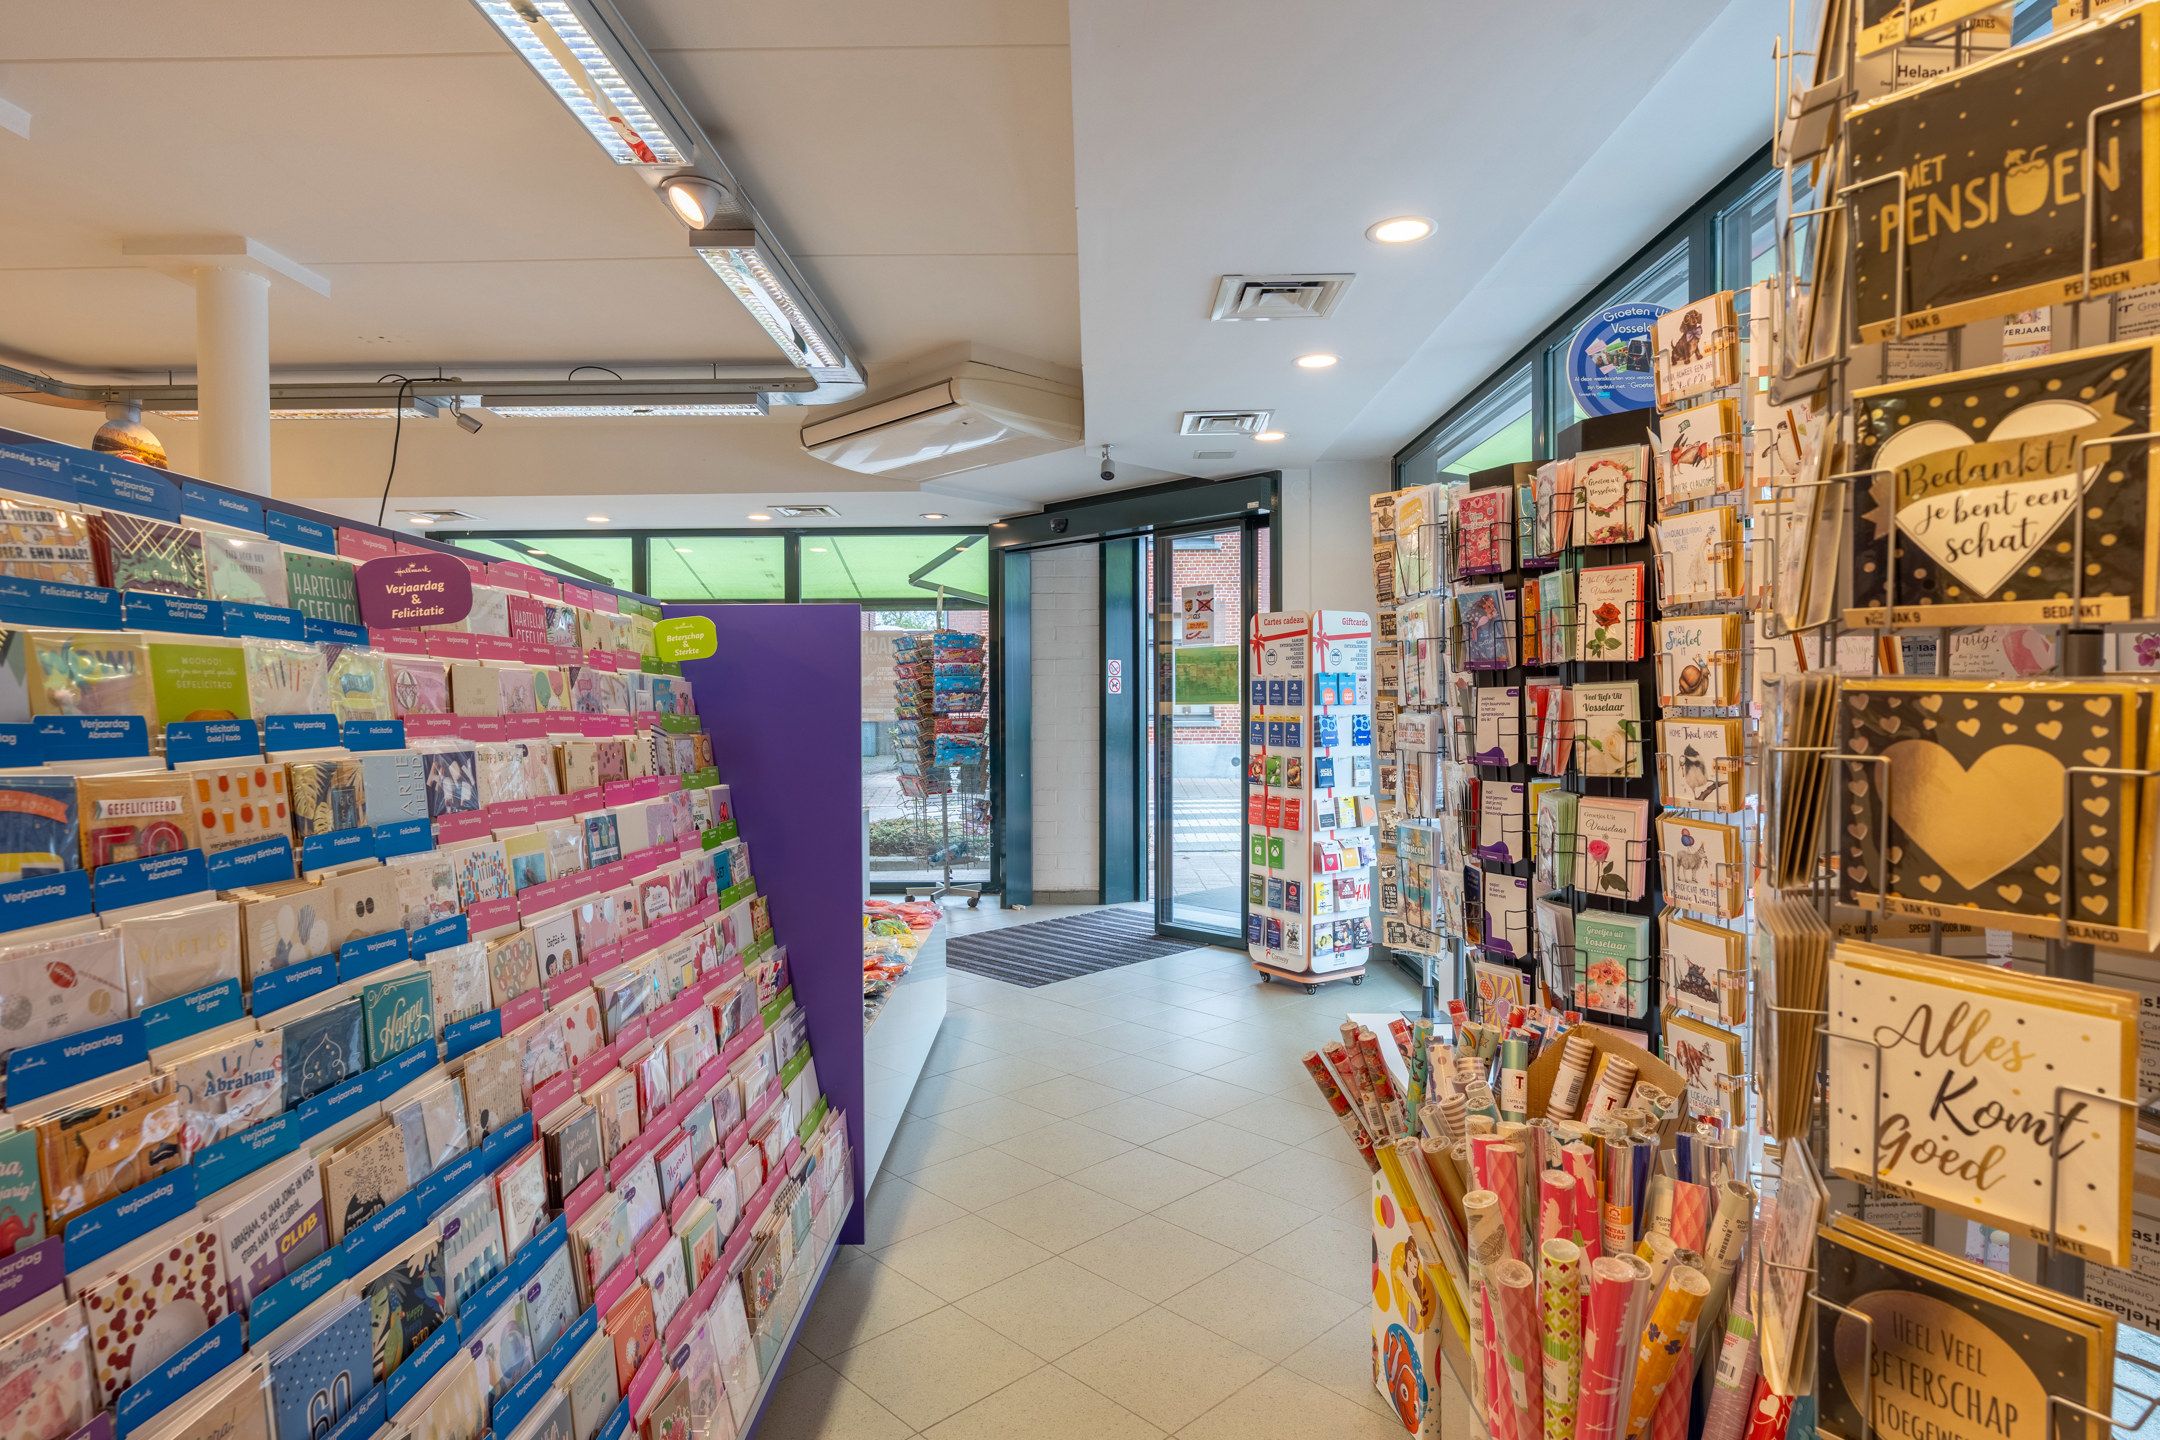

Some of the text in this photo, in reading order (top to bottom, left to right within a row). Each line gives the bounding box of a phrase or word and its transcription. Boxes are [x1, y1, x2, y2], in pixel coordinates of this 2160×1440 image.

[1931, 9, 1937, 21] 7
[1903, 154, 1947, 191] MET
[2064, 271, 2130, 296] PESIOEN
[1603, 307, 1650, 322] Groeten
[1611, 323, 1651, 334] Vossela
[1906, 317, 1930, 330] VAK
[0, 448, 61, 472] jaardag Schijf
[1904, 436, 2078, 497] Bedankt!
[110, 477, 155, 496] Verjaardag
[219, 498, 249, 513] Felicitatie
[1954, 490, 2017, 525] bent
[2025, 487, 2076, 508] een
[297, 525, 323, 538] Felicitatie
[1945, 517, 2042, 564] schat
[292, 573, 354, 600] HARTELIJK
[385, 581, 445, 596] Verjaardag
[40, 586, 109, 604] Felicitatie Schijf
[411, 594, 422, 605] &
[165, 600, 208, 613] Verjaardag
[391, 605, 445, 619] Felicitatie
[254, 611, 290, 624] Verjaardag
[1264, 616, 1304, 626] Cartes cadeau
[1342, 617, 1368, 627] Giftcards
[333, 628, 358, 638] Felicitatie
[392, 635, 418, 645] Verjaardag
[446, 635, 469, 645] Verjaardag
[667, 632, 705, 643] Beterschap
[1665, 627, 1702, 650] Snailed
[675, 648, 700, 657] Sterkte
[1597, 692, 1610, 702] Liefs
[1582, 702, 1625, 712] Vosselaar
[80, 720, 130, 731] Verjaardag
[205, 724, 240, 734] Felicitatie
[293, 721, 327, 731] Verjaardag
[369, 727, 393, 735] Felicitatie
[88, 731, 124, 739] Abraham
[1703, 729, 1719, 739] HOME
[107, 800, 177, 815] GEFELICITEERD
[400, 825, 421, 835] Felicitatie
[1585, 819, 1627, 834] Vosselaar
[334, 836, 361, 847] Felicitatie
[234, 846, 285, 864] Happy Birthday
[139, 856, 188, 872] Verjaardag
[148, 867, 183, 881] Abraham
[3, 885, 66, 903] Verjaardag
[480, 886, 495, 898] YAY!
[1902, 903, 1924, 914] VAK
[435, 923, 456, 935] Felicitatie
[1586, 925, 1612, 938] Groetjes
[1909, 923, 1931, 933] SPECIA
[2066, 927, 2119, 943] BLANCO
[367, 938, 397, 952] Verjaardag
[1583, 936, 1628, 951] Vosselaar
[285, 965, 323, 983] Verjaardag
[185, 985, 230, 1006] Verjaardag
[205, 1000, 221, 1012] jaar
[469, 1018, 491, 1032] Felicitatie
[1873, 1001, 2036, 1072] Alles
[63, 1033, 124, 1058] Verjaardag
[400, 1050, 427, 1070] Verjaardag
[204, 1069, 275, 1097] Abraham
[328, 1084, 363, 1106] Verjaardag
[1930, 1070, 2089, 1160] Komt
[240, 1119, 286, 1144] Verjaardag
[503, 1122, 523, 1139] Felicitatie
[261, 1134, 276, 1148] jaar
[1878, 1113, 2007, 1192] Goed
[443, 1160, 472, 1183] Verjaardag
[117, 1183, 174, 1217] Verjaardag
[267, 1194, 282, 1219] JAAR
[372, 1205, 407, 1233] Verjaardag
[280, 1211, 318, 1254] CLUB
[290, 1256, 332, 1287] Verjaardag
[485, 1275, 509, 1298] Felicitatie
[570, 1318, 589, 1340] Felicitatie
[1893, 1311, 1934, 1356] HEEL
[166, 1336, 221, 1379] Verjaardag
[414, 1335, 445, 1368] Verjaardag
[1940, 1332, 1986, 1377] VEEL
[517, 1370, 543, 1398] Verjaardag
[1870, 1340, 2018, 1438] BETERSCHAP
